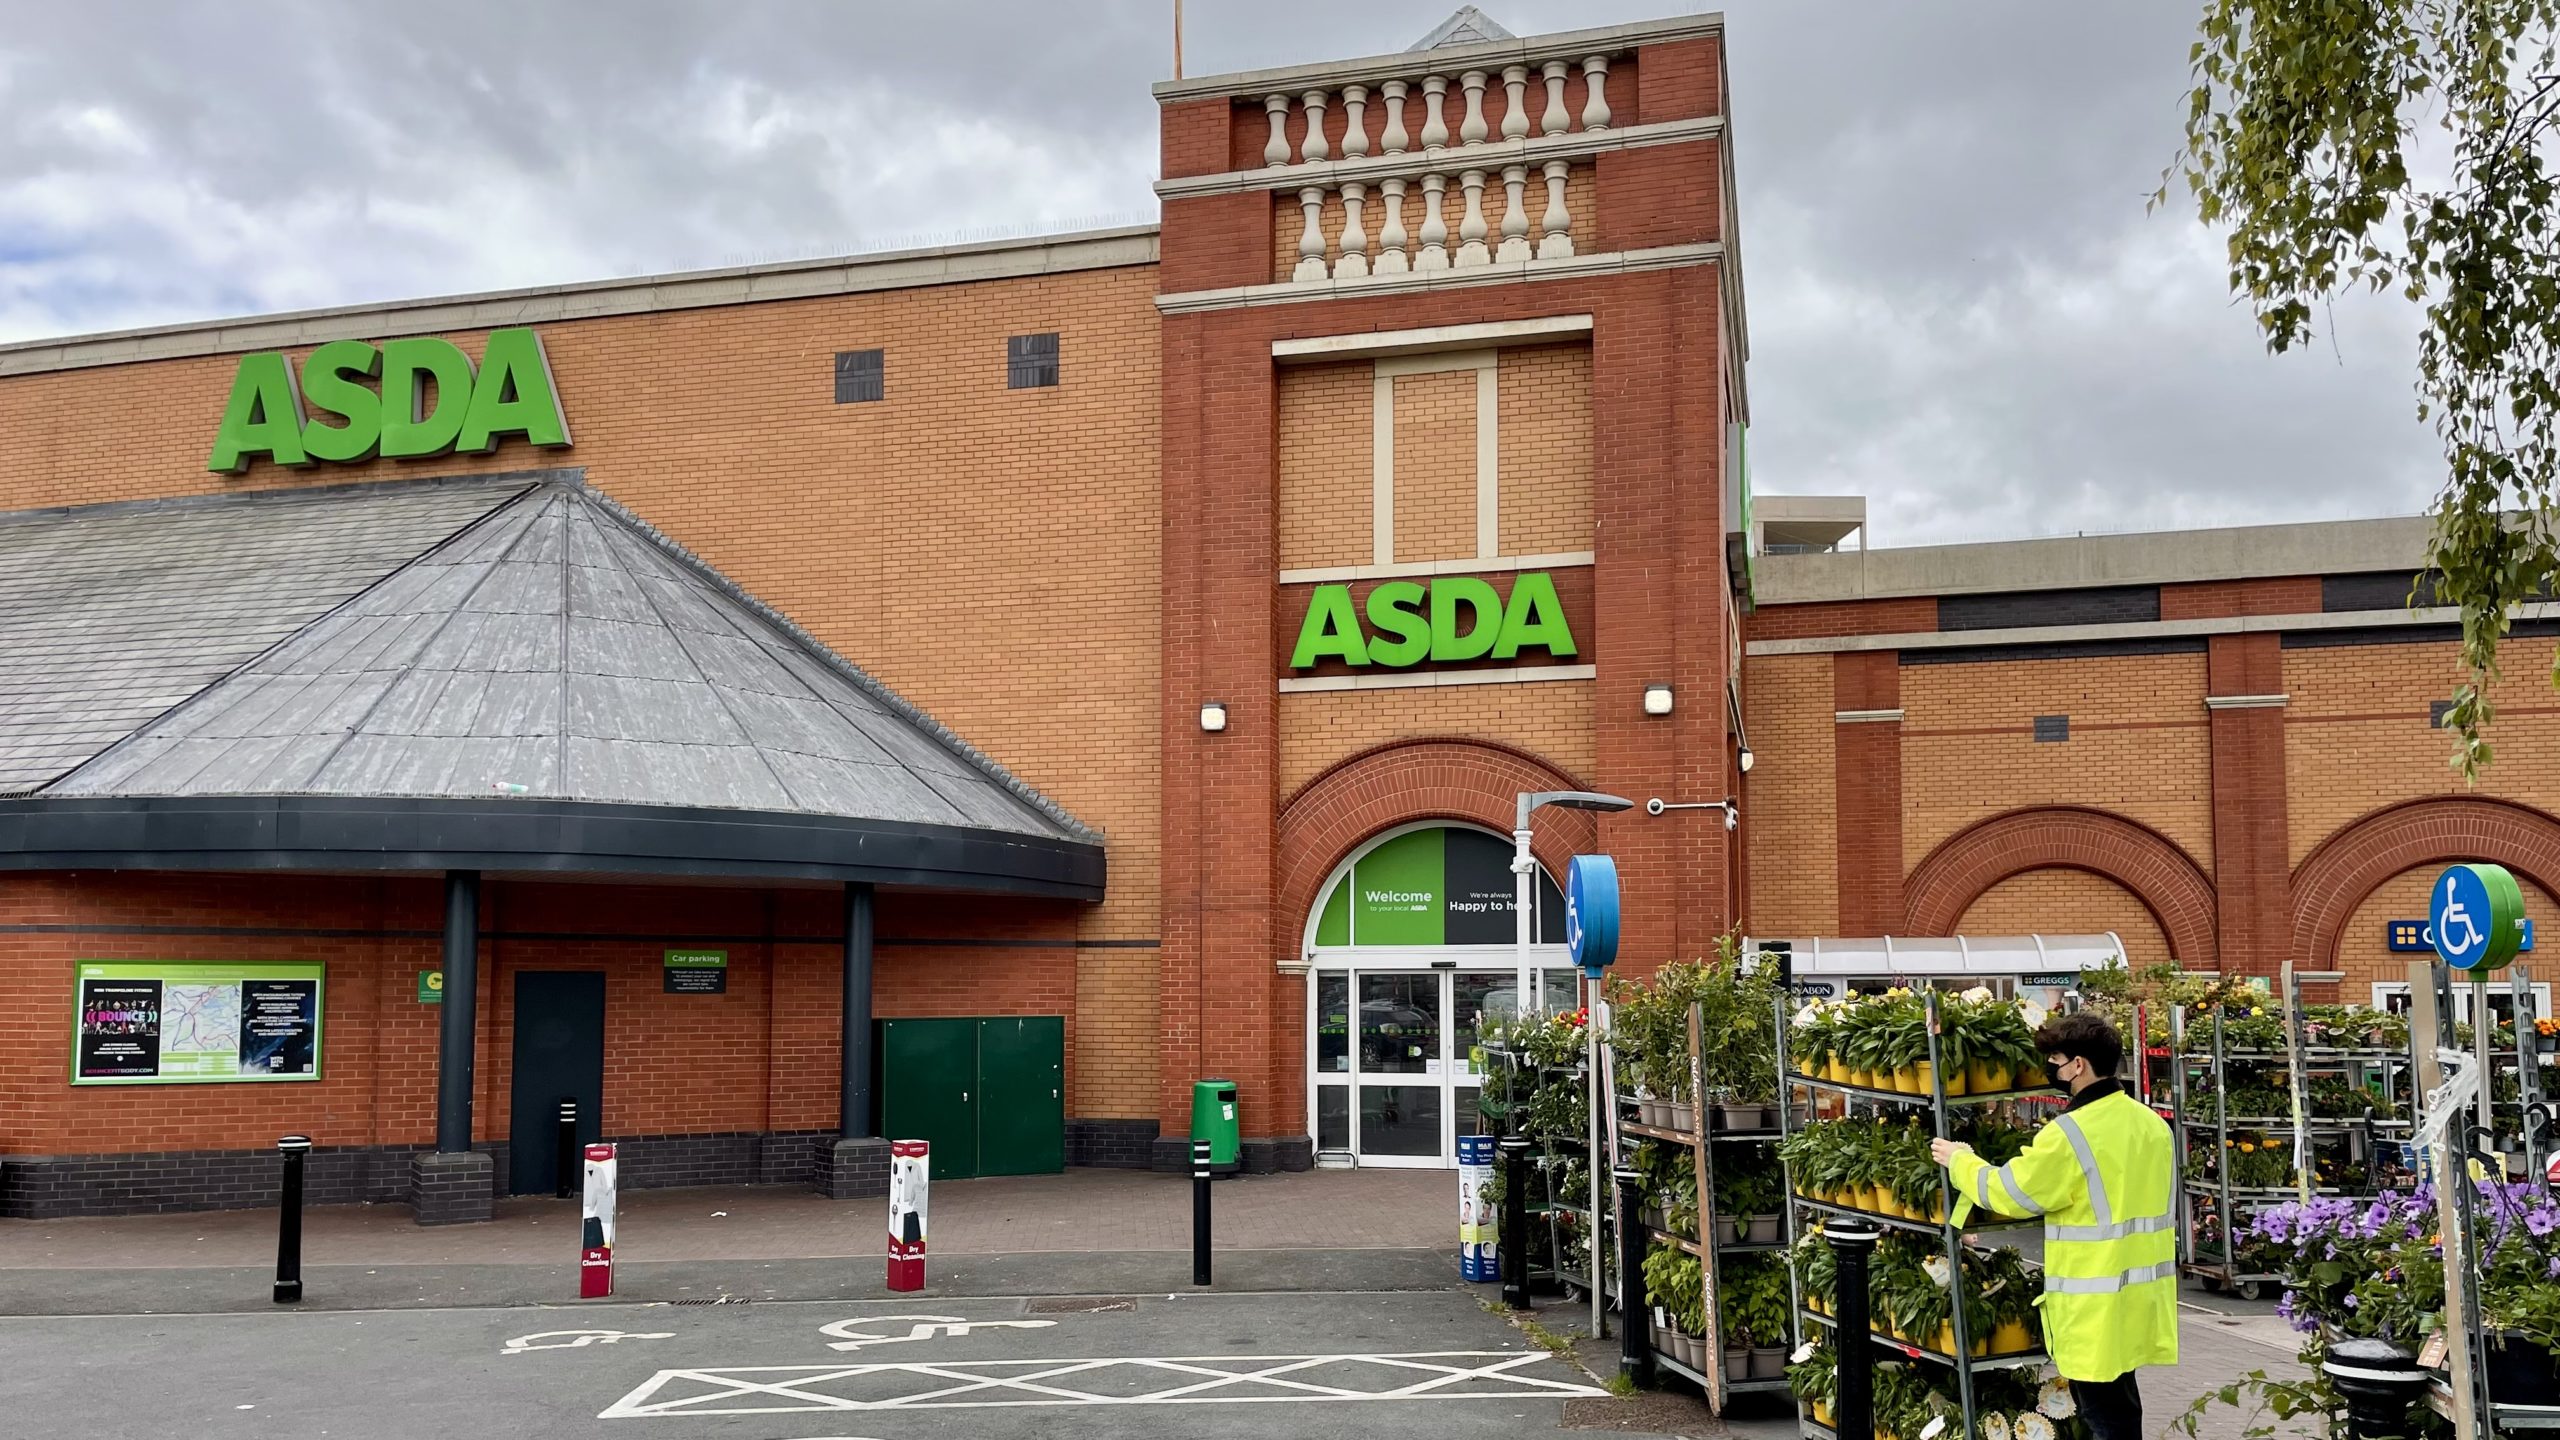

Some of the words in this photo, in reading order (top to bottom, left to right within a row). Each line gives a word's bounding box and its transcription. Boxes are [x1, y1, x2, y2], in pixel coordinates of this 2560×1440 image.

[208, 326, 571, 473] ASDA
[1289, 571, 1578, 669] ASDA
[1365, 890, 1432, 902] Welcome
[1490, 892, 1512, 900] always
[1449, 901, 1487, 912] Happy
[1490, 901, 1503, 911] to
[688, 955, 720, 964] parking
[2033, 977, 2070, 985] GREGGS
[98, 1010, 146, 1022] BOUNCE
[909, 1245, 919, 1253] Dry
[590, 1252, 602, 1260] Dry
[902, 1252, 925, 1261] Cleaning
[582, 1258, 609, 1267] Cleaning
